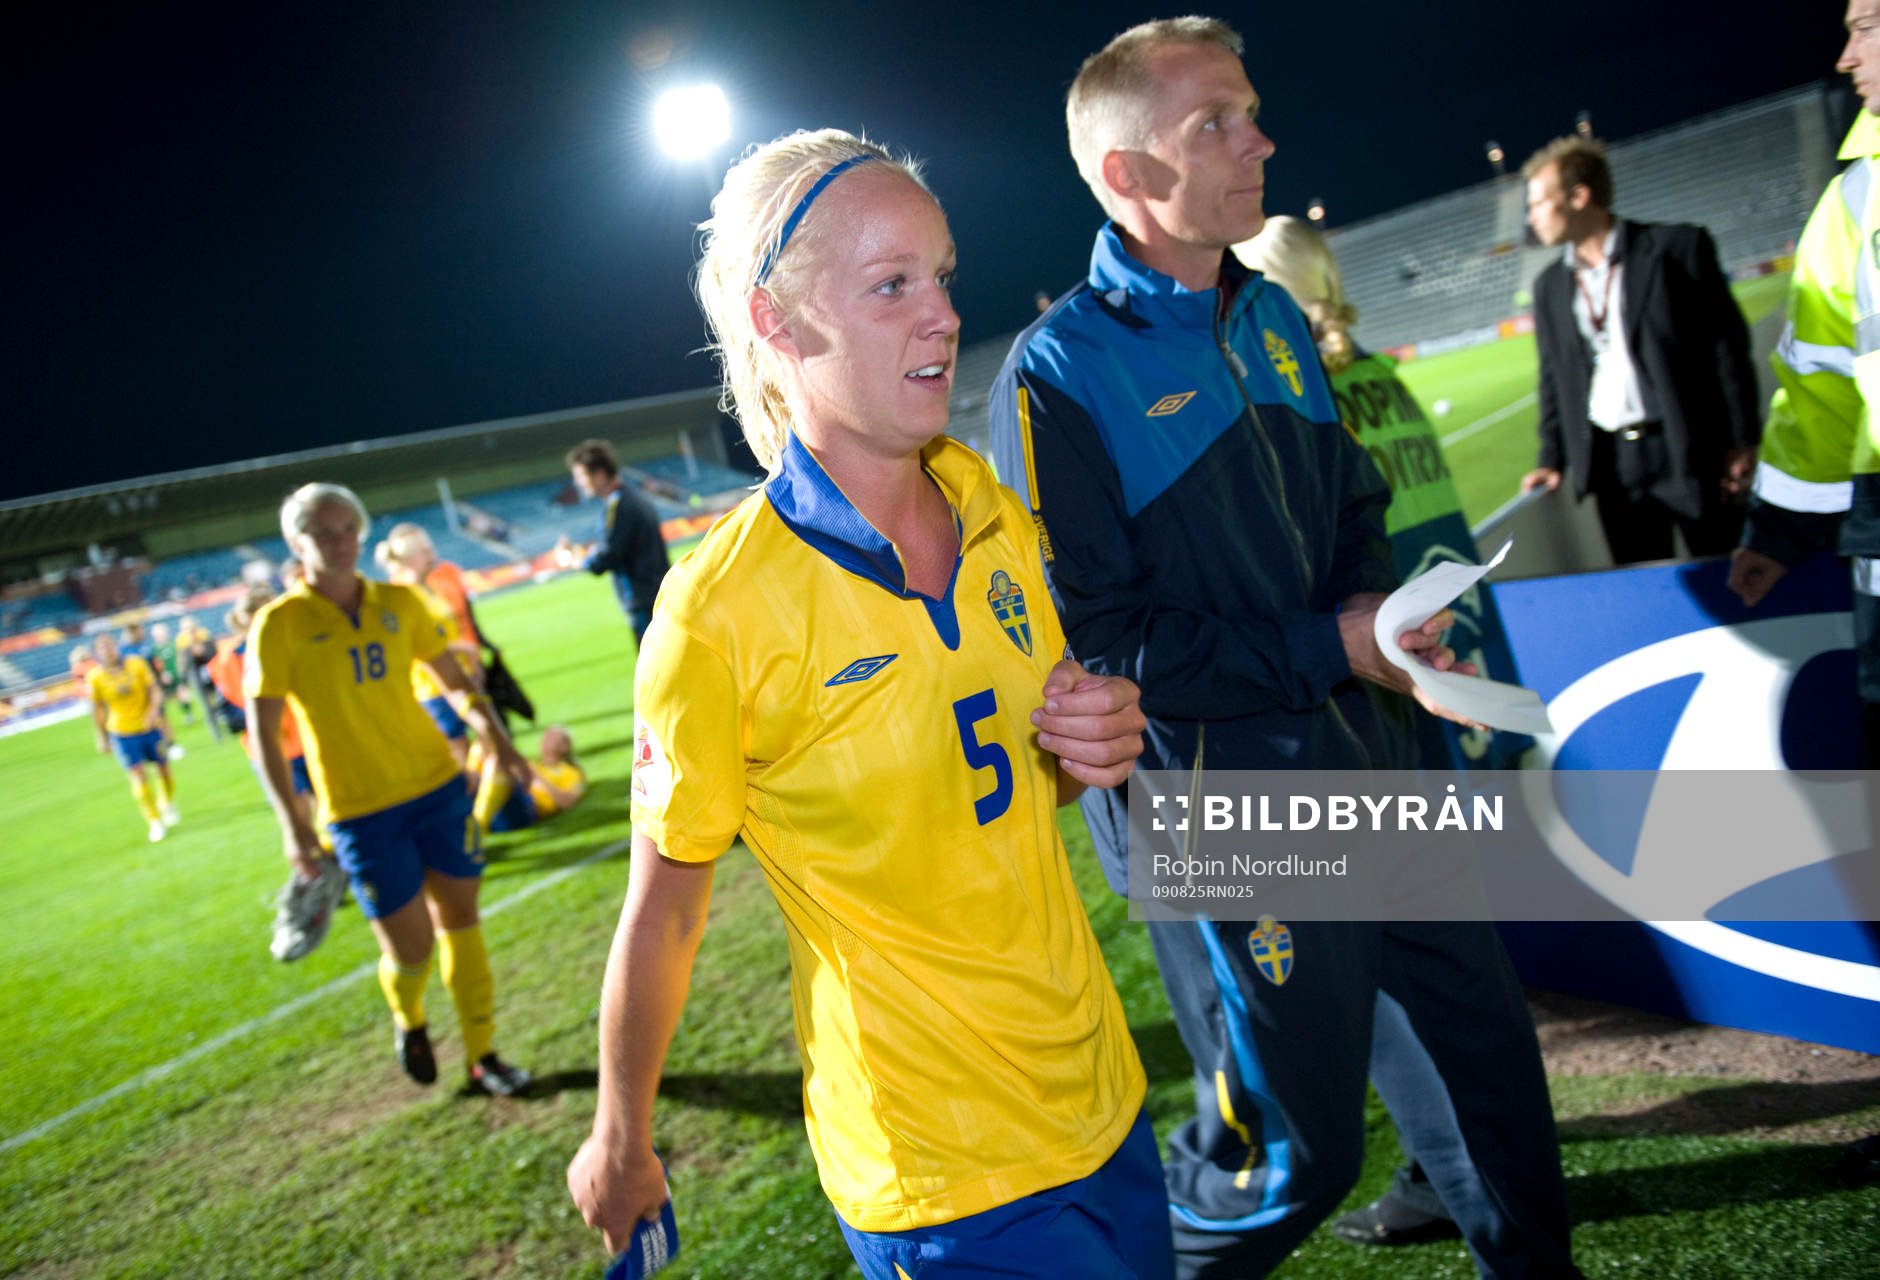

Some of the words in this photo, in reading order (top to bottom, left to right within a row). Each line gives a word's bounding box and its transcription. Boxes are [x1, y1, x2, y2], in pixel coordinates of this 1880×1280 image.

[1032, 514, 1055, 563] SVERIGE
[349, 642, 387, 684] 18
[952, 688, 1013, 826] 5
